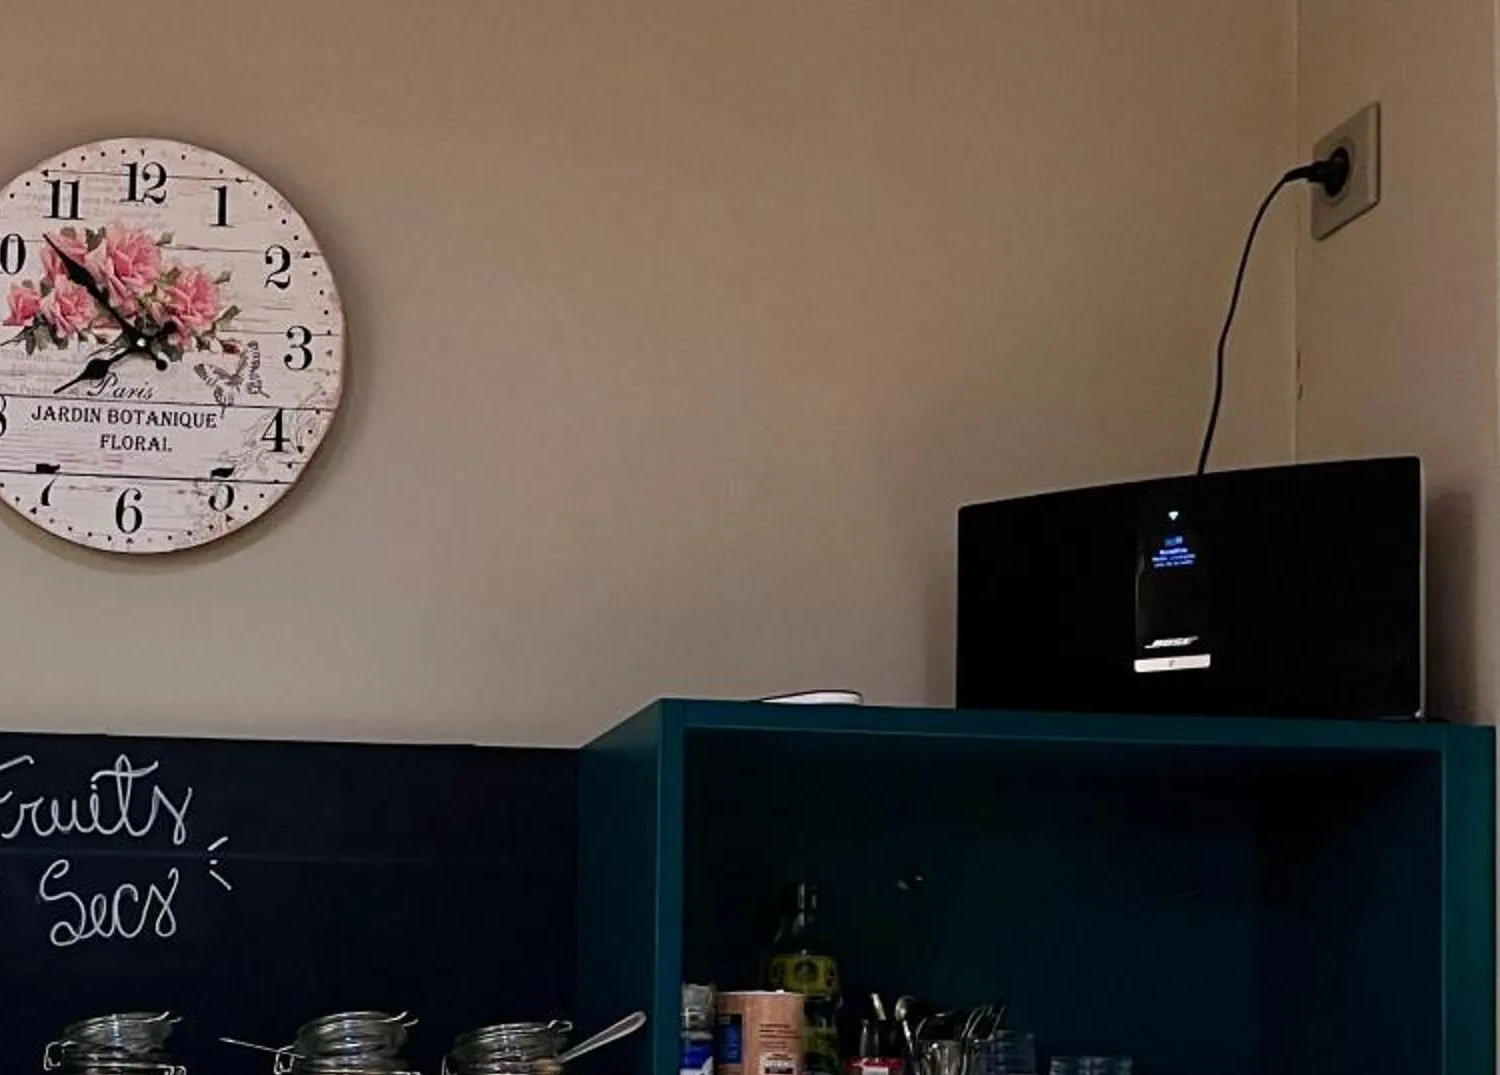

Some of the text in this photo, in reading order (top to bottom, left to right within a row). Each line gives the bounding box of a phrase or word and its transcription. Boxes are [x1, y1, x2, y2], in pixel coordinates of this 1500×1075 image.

[44, 179, 84, 220] 11
[122, 162, 167, 204] 12
[209, 185, 234, 228] 1
[265, 245, 292, 289] 2
[283, 325, 313, 370] 3
[86, 371, 155, 400] Paris
[31, 402, 218, 429] JARDIN BOTANIQUE
[261, 407, 291, 453] 4
[100, 434, 173, 452] FLORAL
[35, 463, 61, 507] 7
[208, 466, 235, 511] 5
[114, 488, 143, 534] 6
[39, 859, 180, 947] Secs
